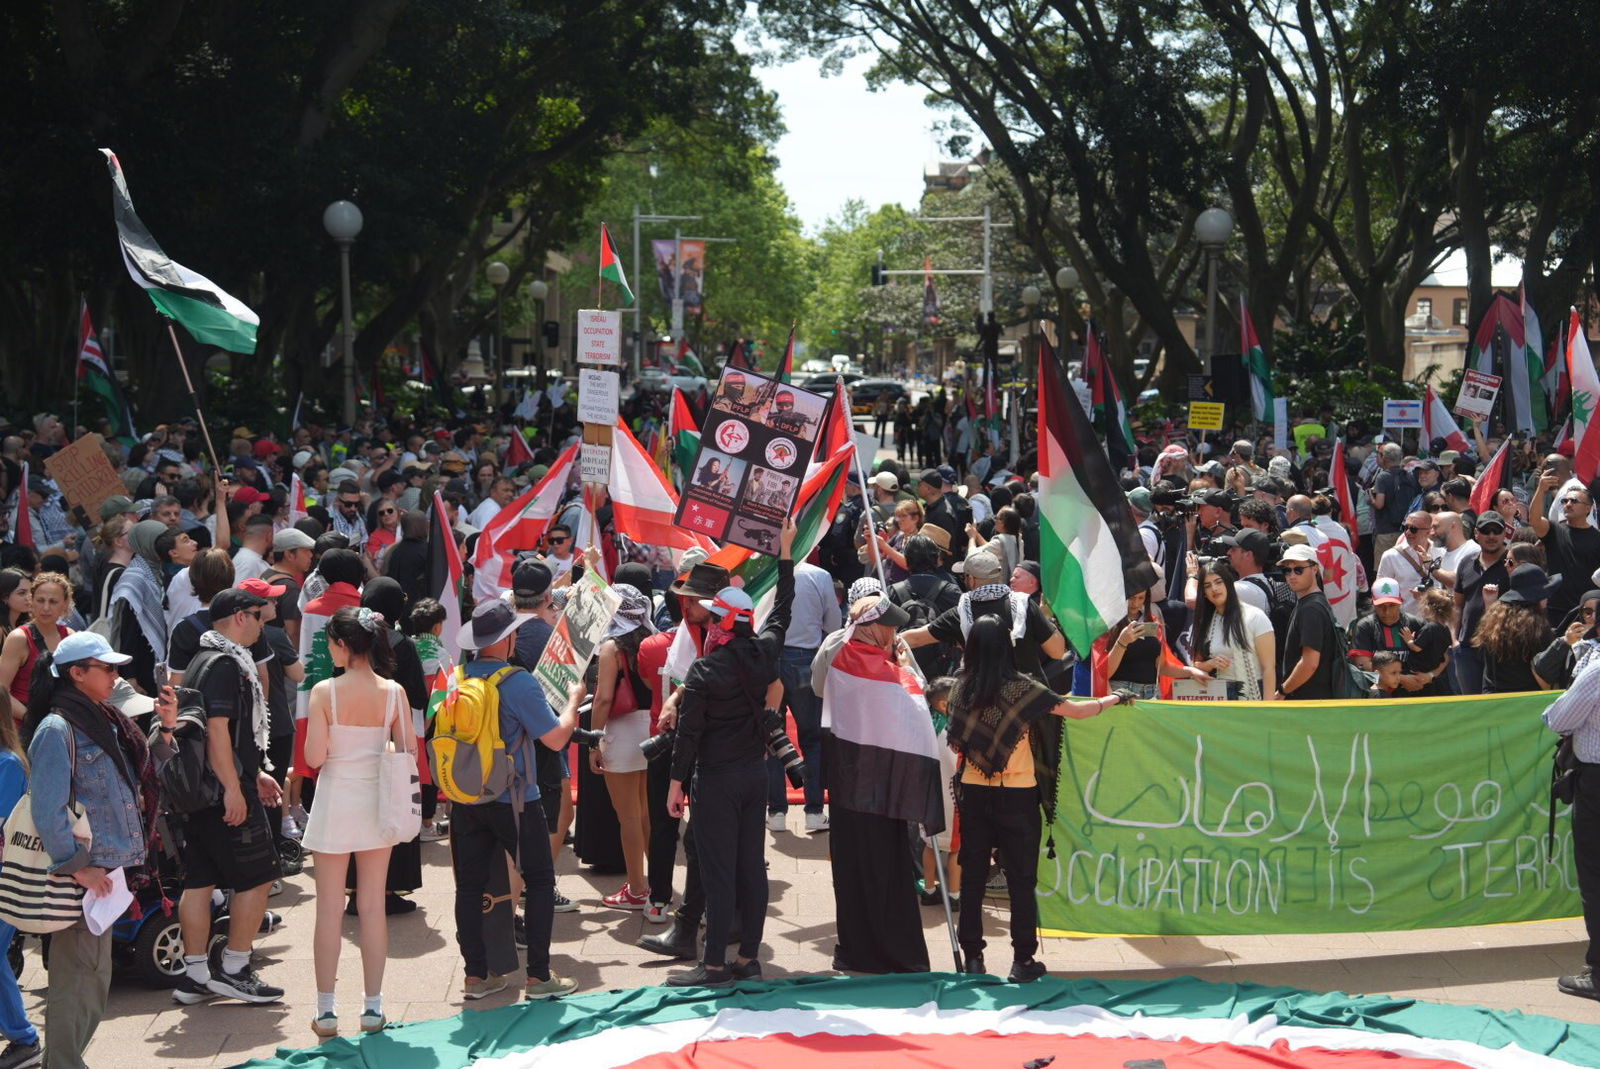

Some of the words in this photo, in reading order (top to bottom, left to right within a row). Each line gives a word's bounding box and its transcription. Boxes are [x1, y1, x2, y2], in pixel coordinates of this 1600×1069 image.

[584, 327, 613, 335] OCCUPATION
[592, 340, 604, 348] STATE
[584, 352, 611, 360] TERRORISM
[732, 404, 751, 413] PFLP
[781, 422, 799, 432] DFLP
[57, 446, 85, 471] STOP
[549, 633, 569, 661] FREE
[540, 653, 574, 690] PALESTIN
[1327, 857, 1374, 914] IS
